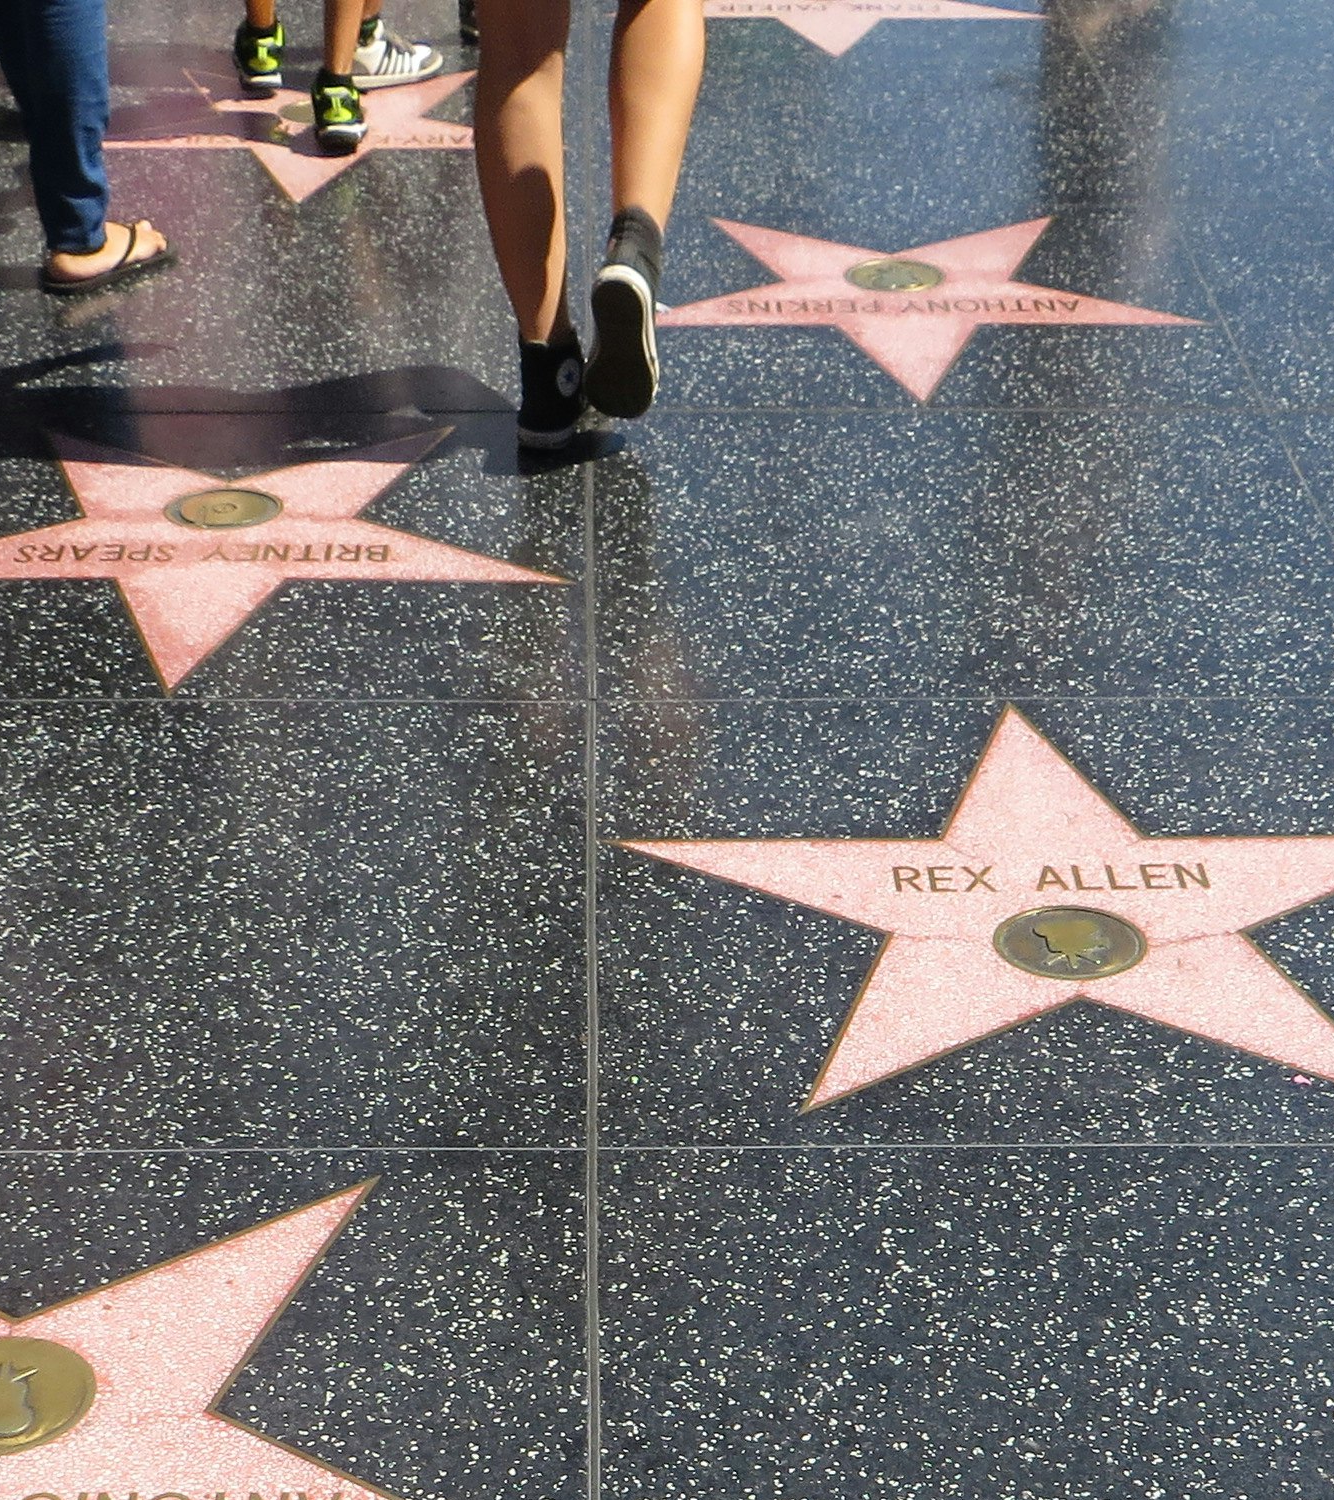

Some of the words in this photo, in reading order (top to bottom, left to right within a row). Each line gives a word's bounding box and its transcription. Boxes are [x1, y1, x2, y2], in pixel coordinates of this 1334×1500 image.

[726, 299, 880, 316] PERKINS
[900, 299, 1080, 315] ANTHONY
[13, 544, 176, 564] SPEARS
[203, 543, 392, 563] BRITNEY
[892, 865, 998, 893] REX
[1036, 862, 1212, 892] ALLEN
